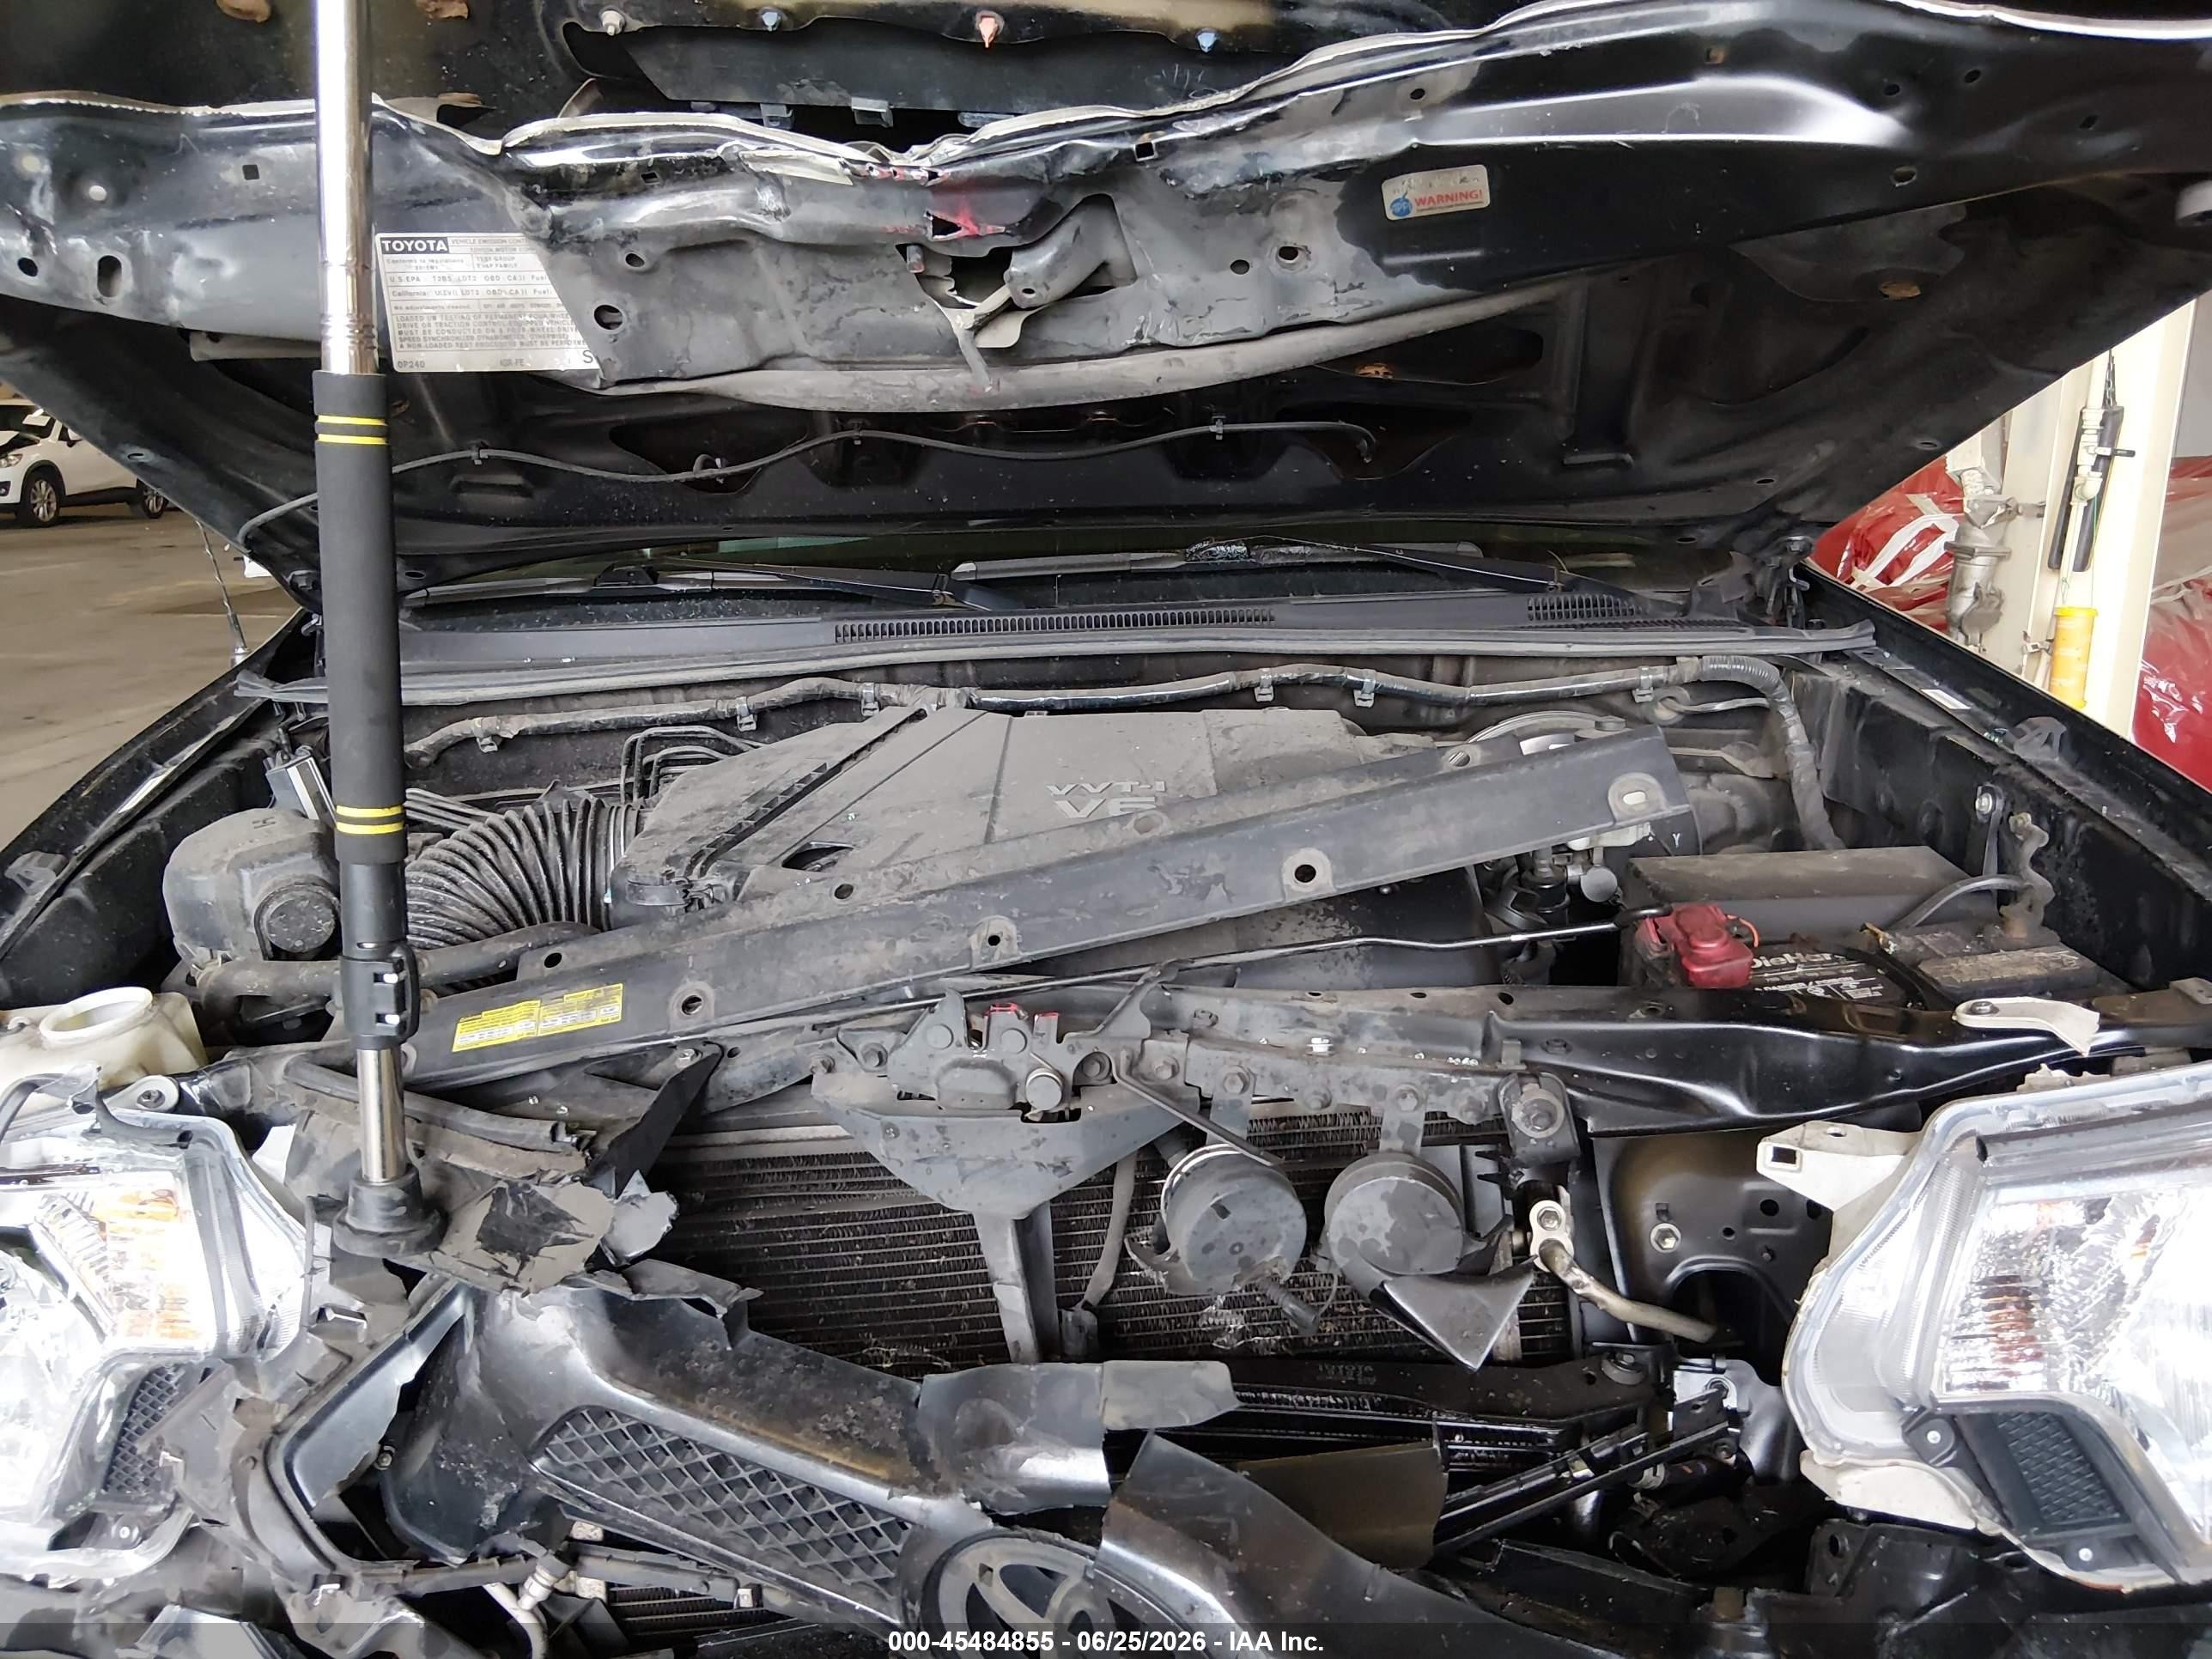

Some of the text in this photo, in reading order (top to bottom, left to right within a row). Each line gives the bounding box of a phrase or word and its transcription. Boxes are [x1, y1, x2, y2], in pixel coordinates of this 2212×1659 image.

[1415, 189, 1483, 206] WARNING!
[381, 240, 448, 252] TOYOTA
[582, 349, 594, 364] S
